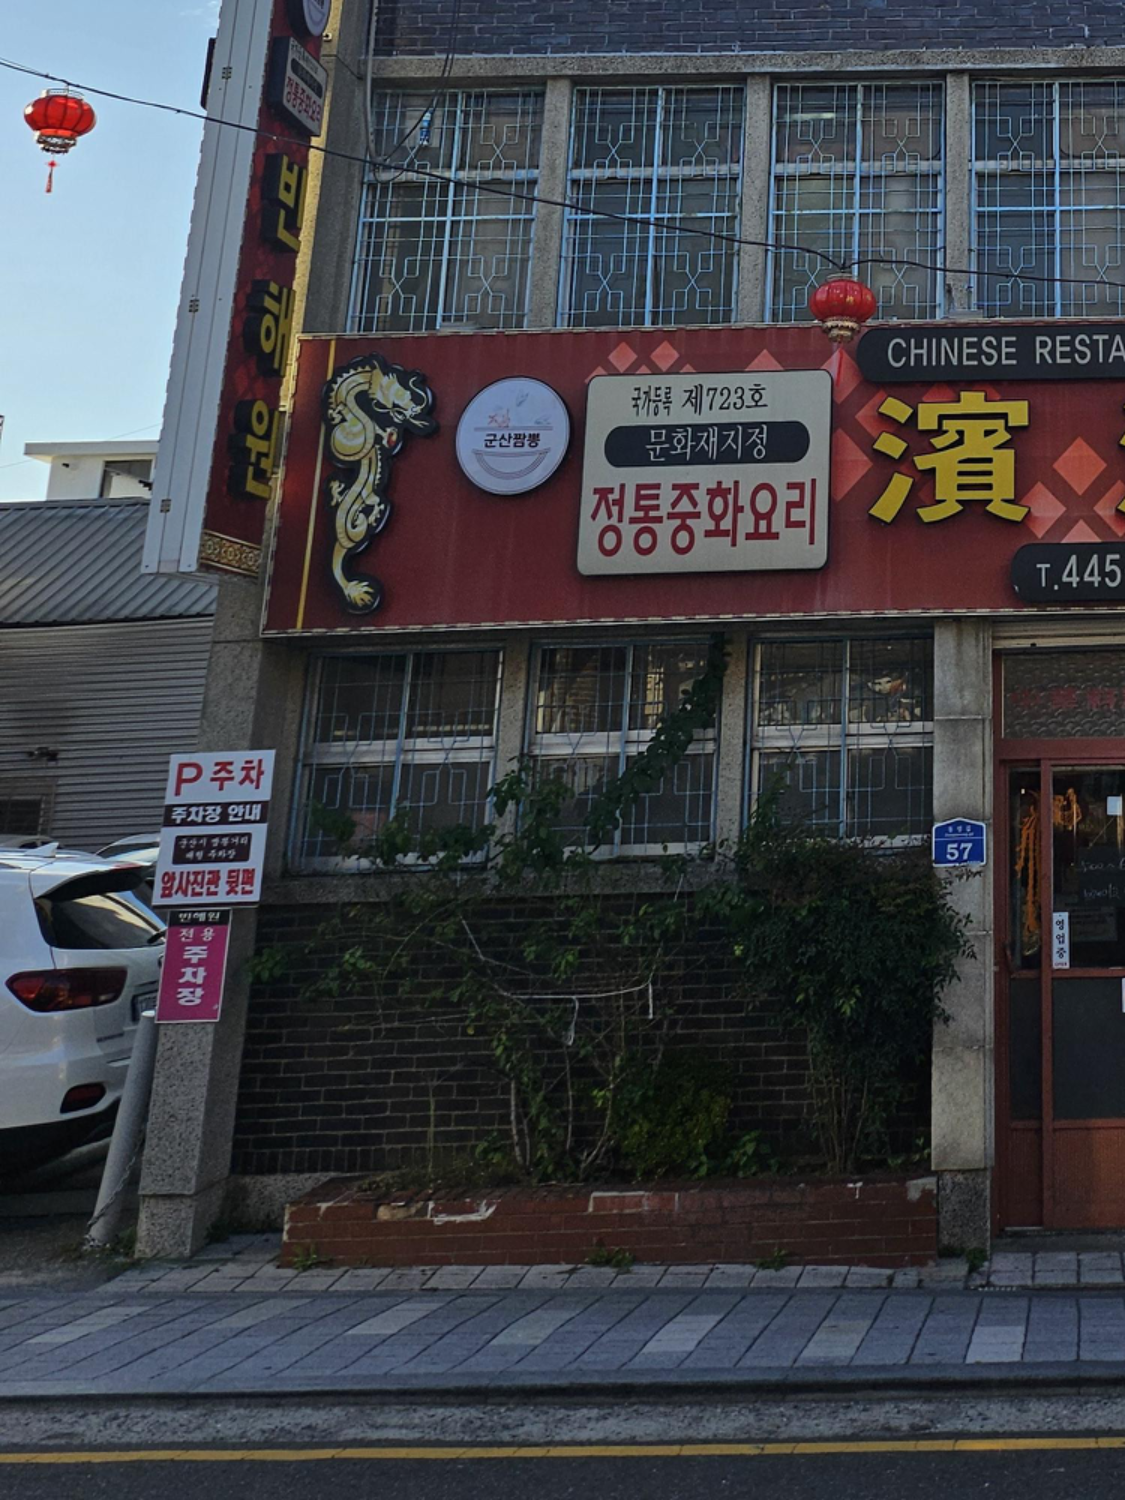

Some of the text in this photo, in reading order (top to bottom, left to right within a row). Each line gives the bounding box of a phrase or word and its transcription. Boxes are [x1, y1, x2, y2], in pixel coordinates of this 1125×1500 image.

[886, 333, 1018, 368] CHINESE
[631, 383, 769, 418] 국가등록 제723호
[483, 431, 542, 449] 군산짬뽕
[645, 424, 768, 461] 문화재지정
[590, 477, 818, 557] 정통중화요리
[174, 758, 266, 797] P 주차
[171, 804, 262, 825] 주차장 안내
[946, 842, 973, 861] 57
[1055, 918, 1067, 959] 영업중
[175, 945, 209, 1007] 주차장
